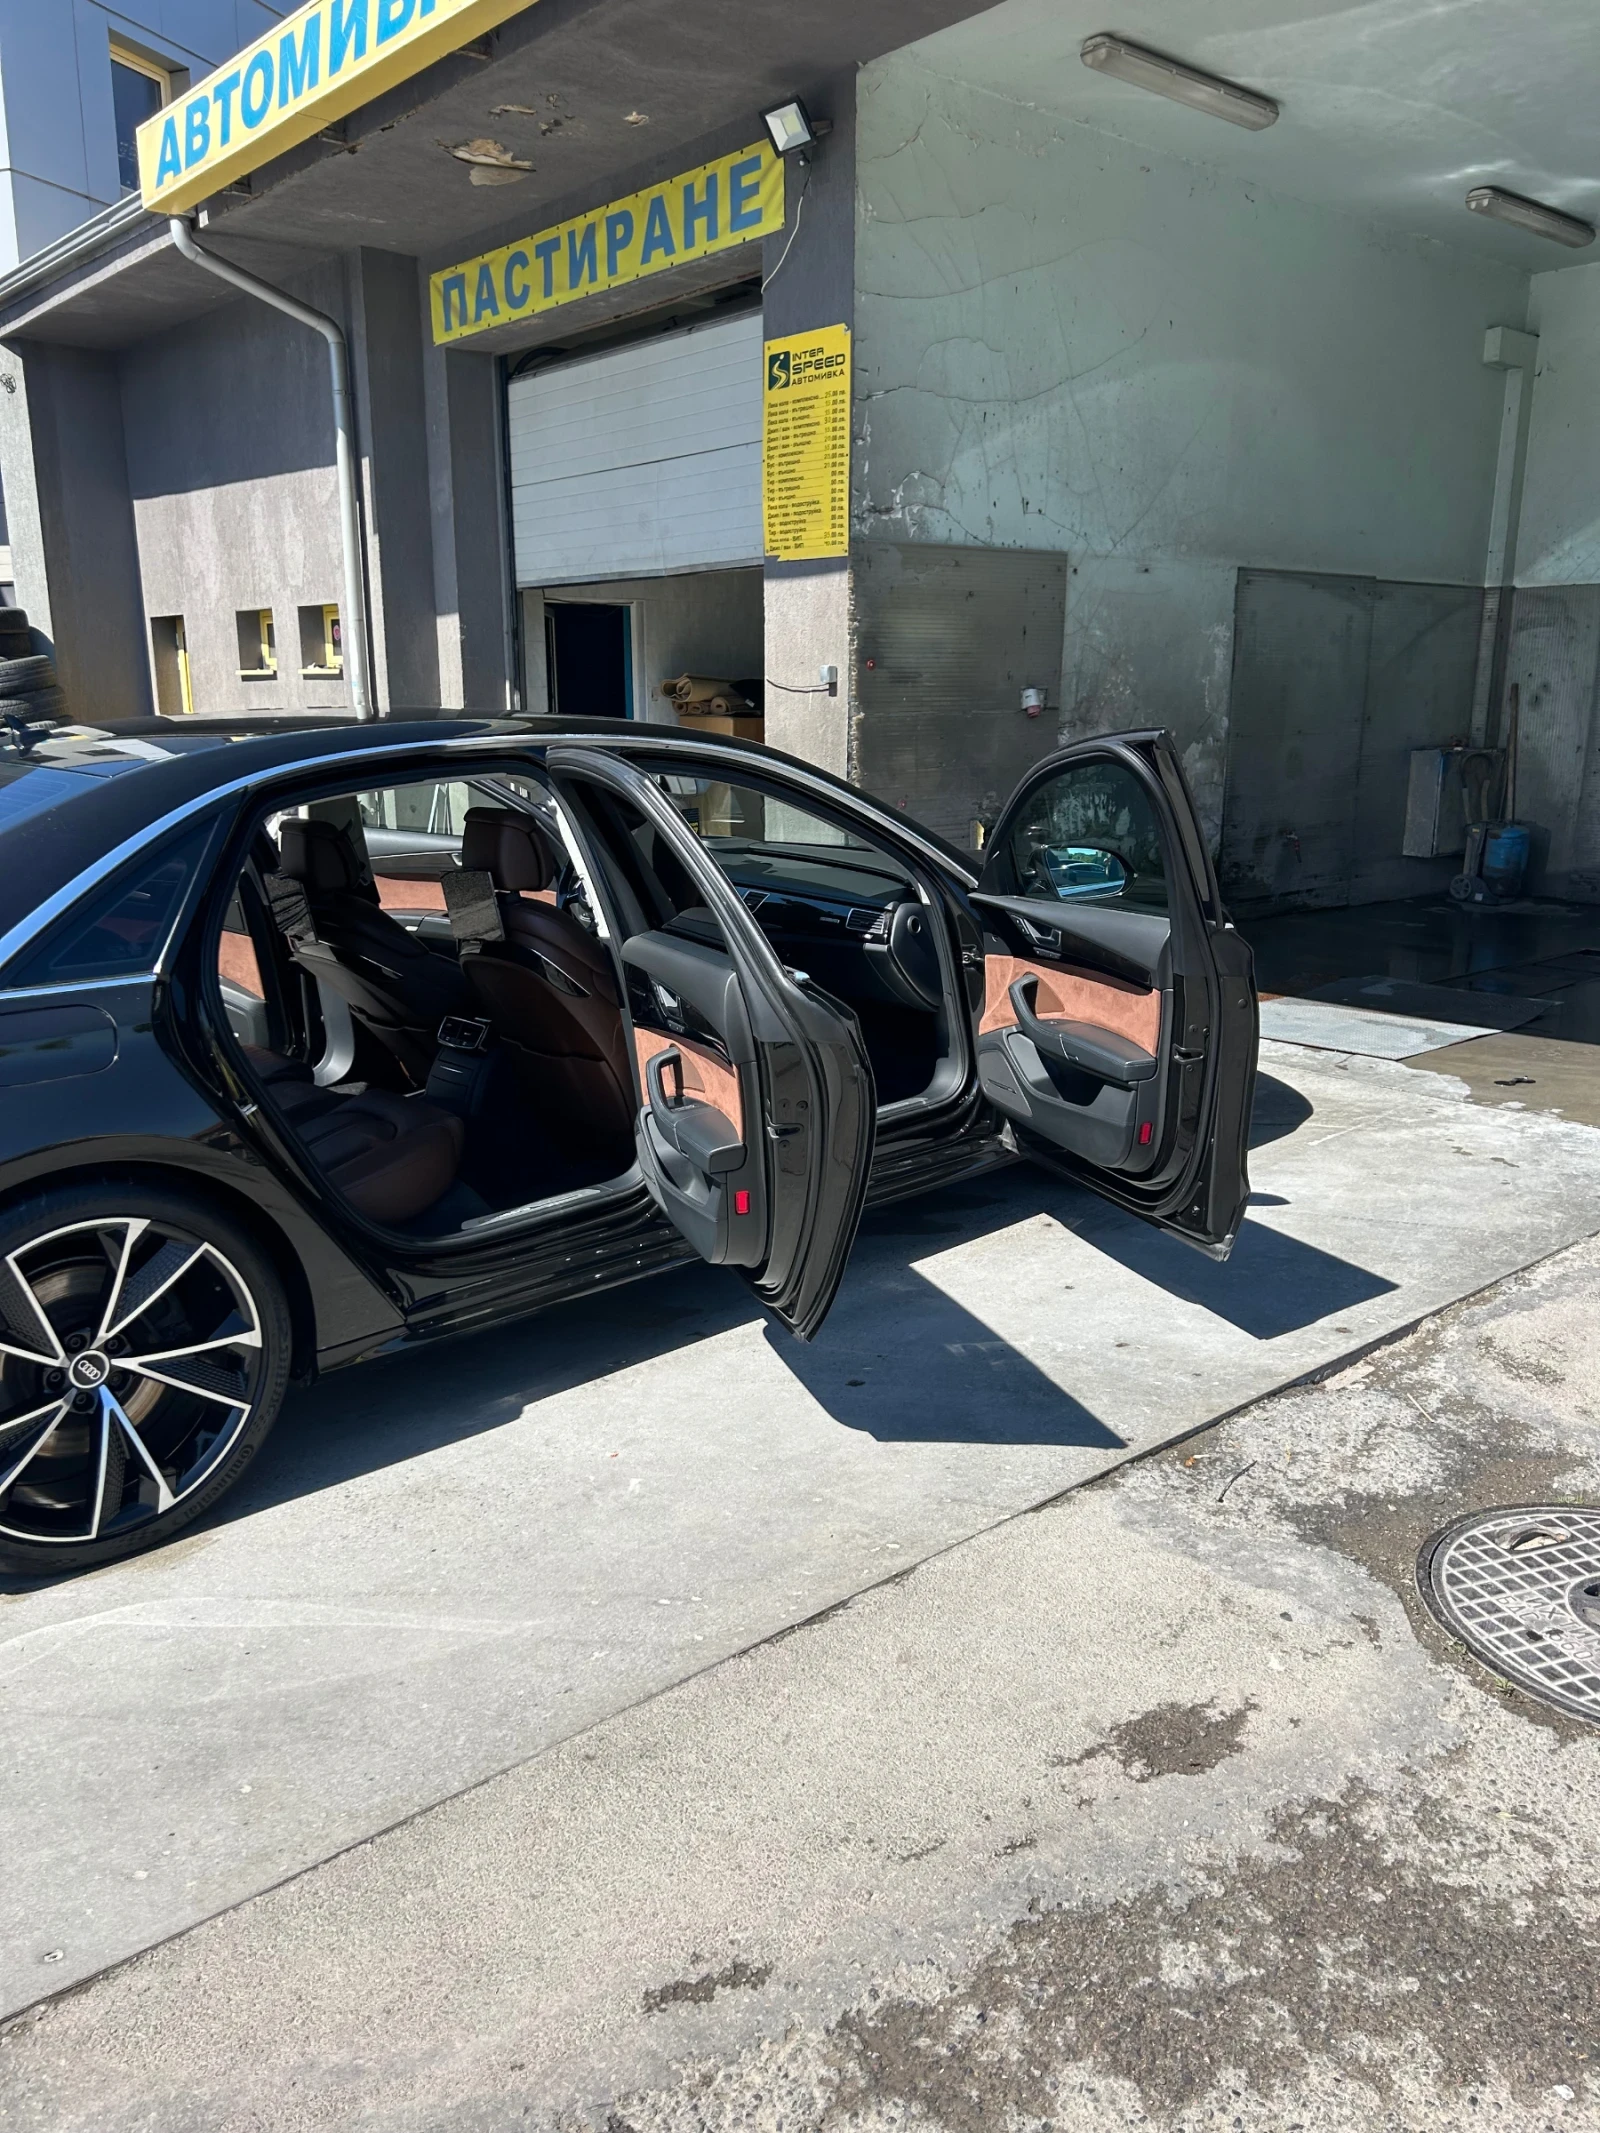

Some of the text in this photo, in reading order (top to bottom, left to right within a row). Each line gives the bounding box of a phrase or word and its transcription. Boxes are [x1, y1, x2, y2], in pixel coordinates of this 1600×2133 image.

[156, 0, 437, 189] АВТОМИВ
[442, 154, 763, 332] ПАСТИРАНЕ
[792, 347, 824, 362] INTER
[792, 353, 846, 375] SPEED
[791, 368, 845, 386] АВТОМИВКА
